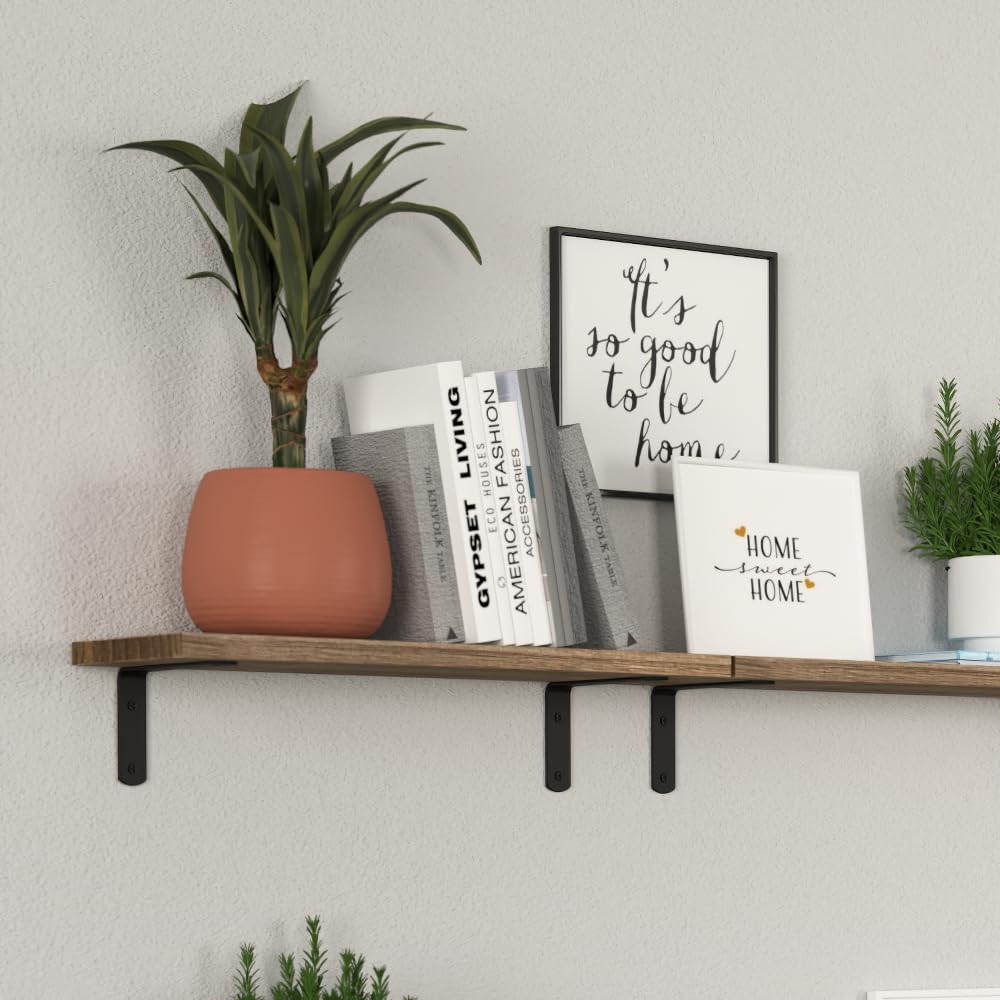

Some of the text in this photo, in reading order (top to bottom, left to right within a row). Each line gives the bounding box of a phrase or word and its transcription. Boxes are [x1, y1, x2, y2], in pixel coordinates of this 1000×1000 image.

[623, 257, 697, 334] It's
[587, 320, 737, 389] so good
[602, 362, 704, 424] to be
[447, 386, 490, 608] GYPSET LIVING
[476, 442, 497, 533] ECO HOUSES
[482, 388, 528, 615] AMERICAN FASHION
[511, 447, 535, 557] ACCESSORIES
[586, 492, 610, 553] KINFOLK
[746, 534, 802, 560] HOME
[714, 562, 836, 577] sweet
[750, 578, 806, 603] HOME
